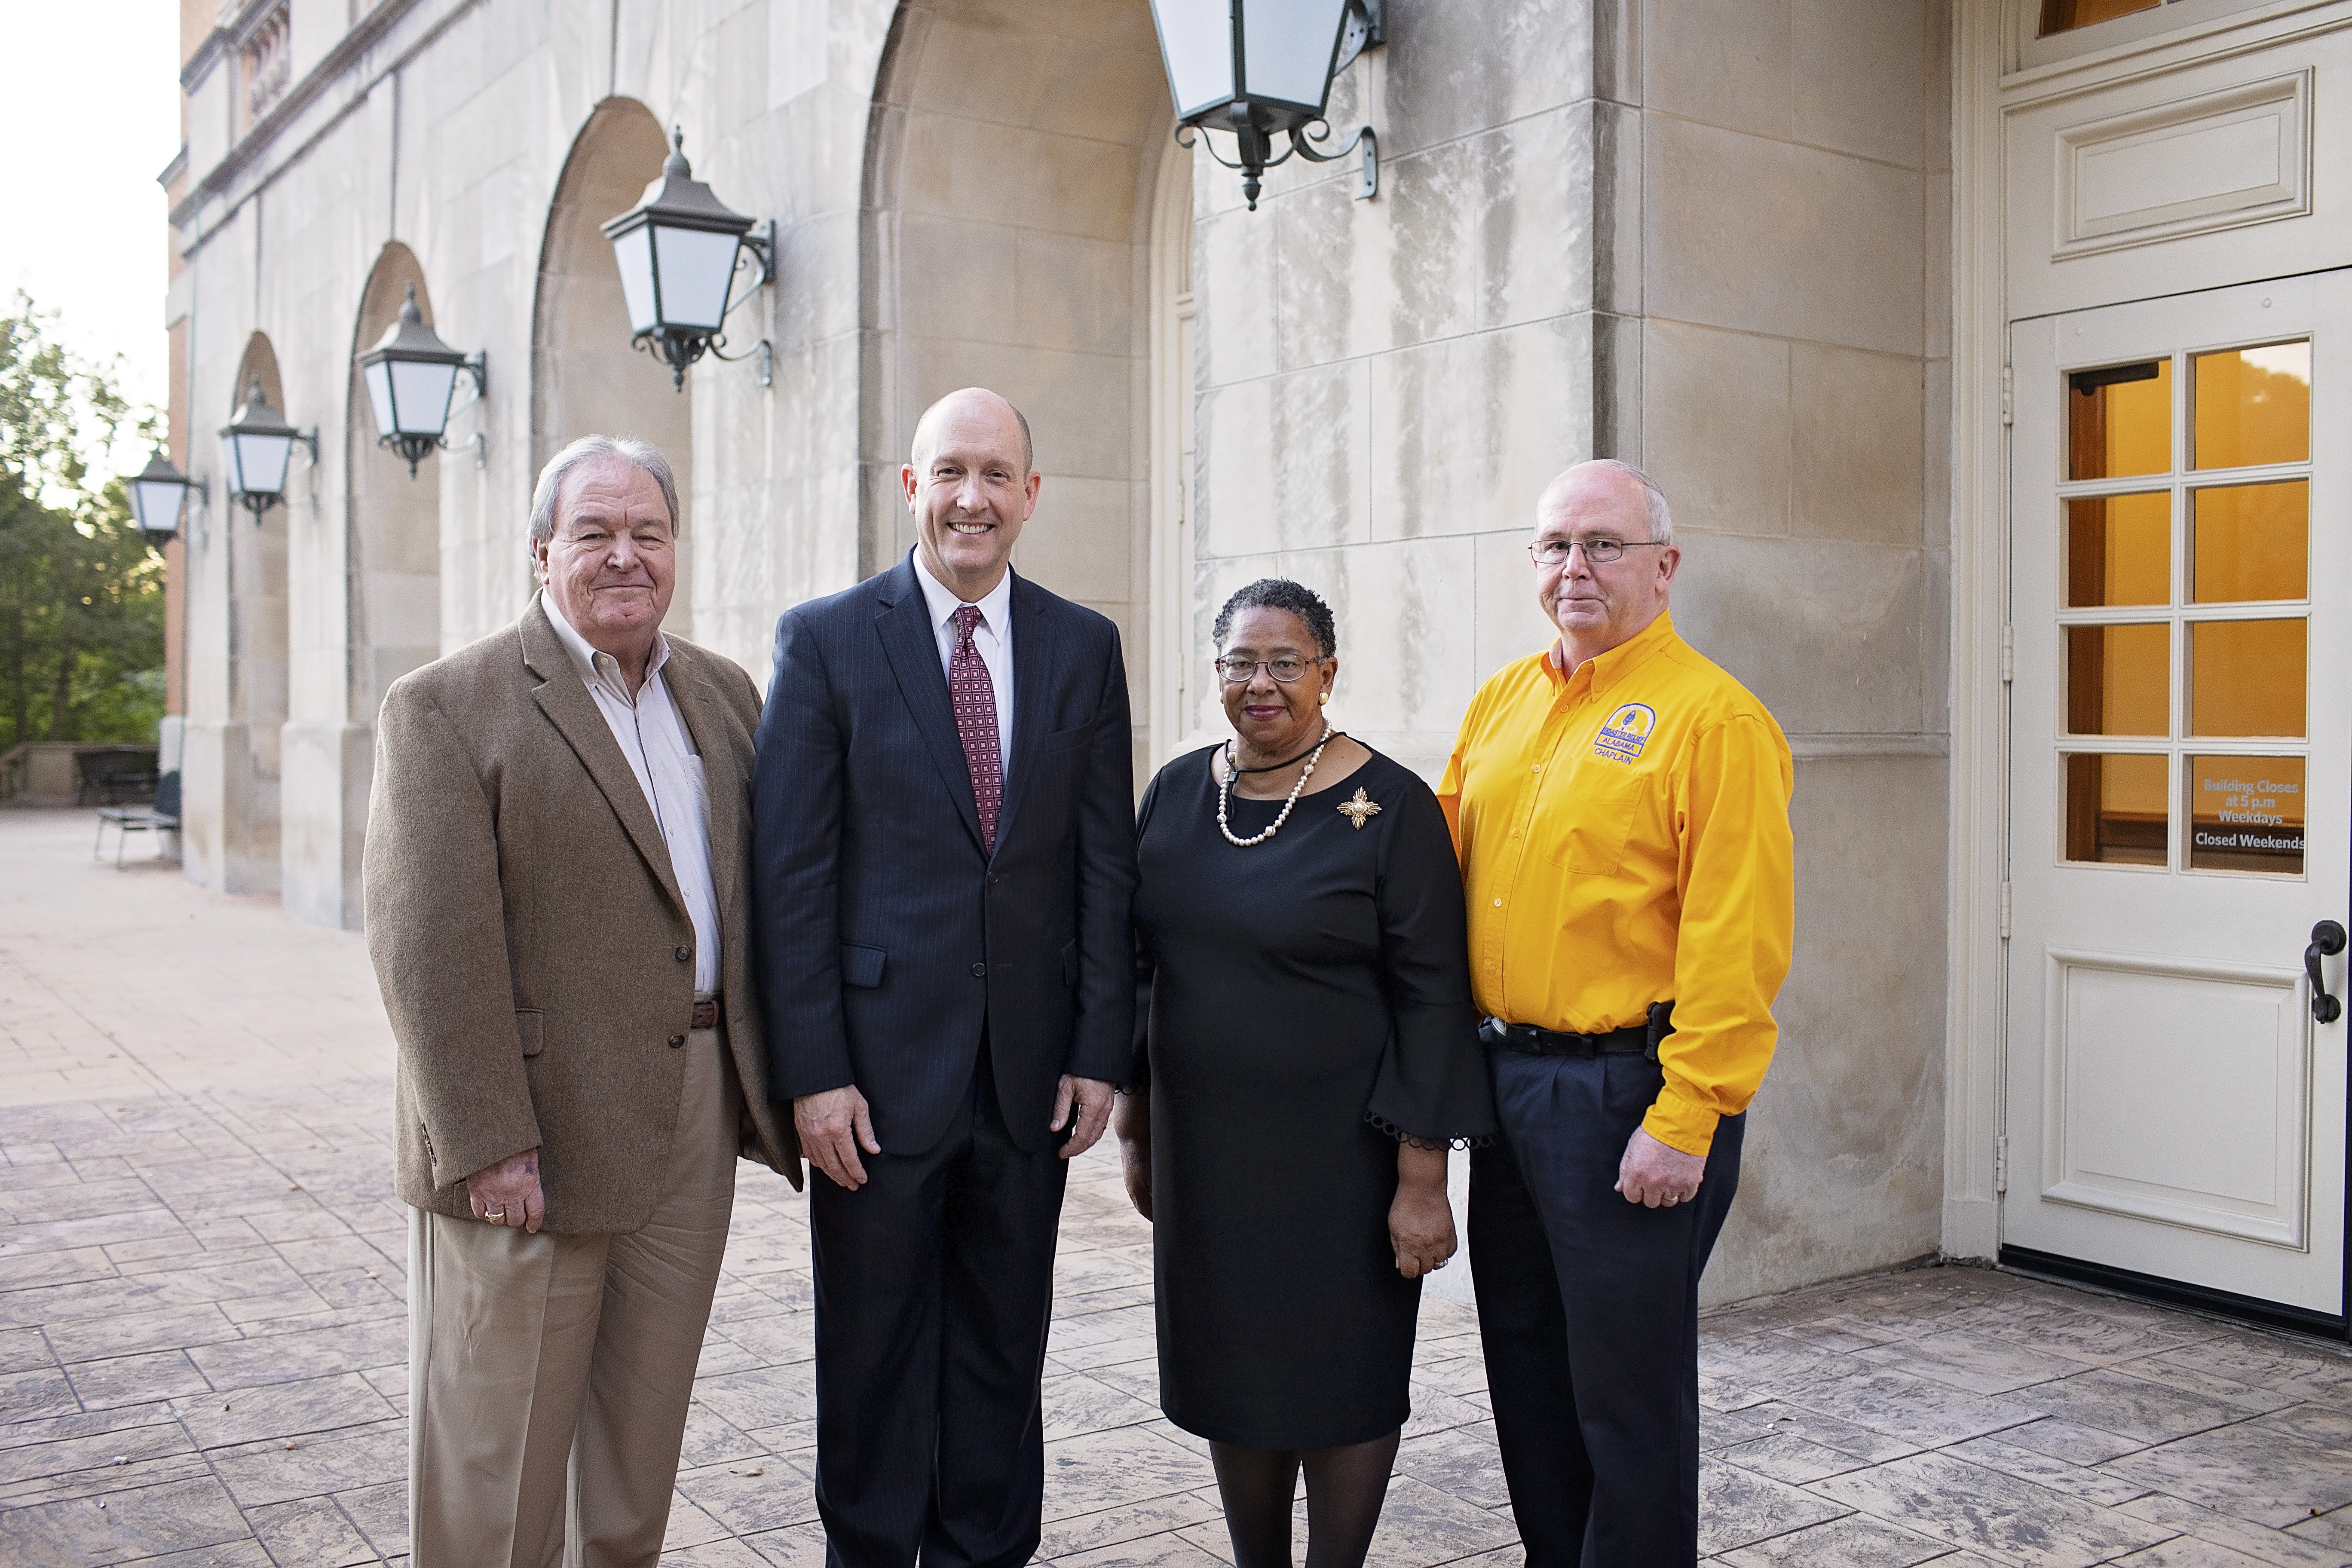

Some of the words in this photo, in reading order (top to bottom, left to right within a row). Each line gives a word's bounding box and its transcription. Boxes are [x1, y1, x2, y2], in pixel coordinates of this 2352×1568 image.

[1602, 727, 1627, 738] DISASTER
[1626, 732, 1645, 744] RELIEF
[1602, 737, 1634, 751] ALABAMA
[1594, 748, 1633, 765] CHAPLAIN
[2204, 779, 2254, 795] Building
[2257, 780, 2299, 793] Closes
[2226, 796, 2238, 806] at
[2241, 795, 2249, 807] 5
[2218, 810, 2283, 827] Weekdays
[2196, 832, 2236, 846] Closed
[2239, 834, 2304, 849] Weekends
